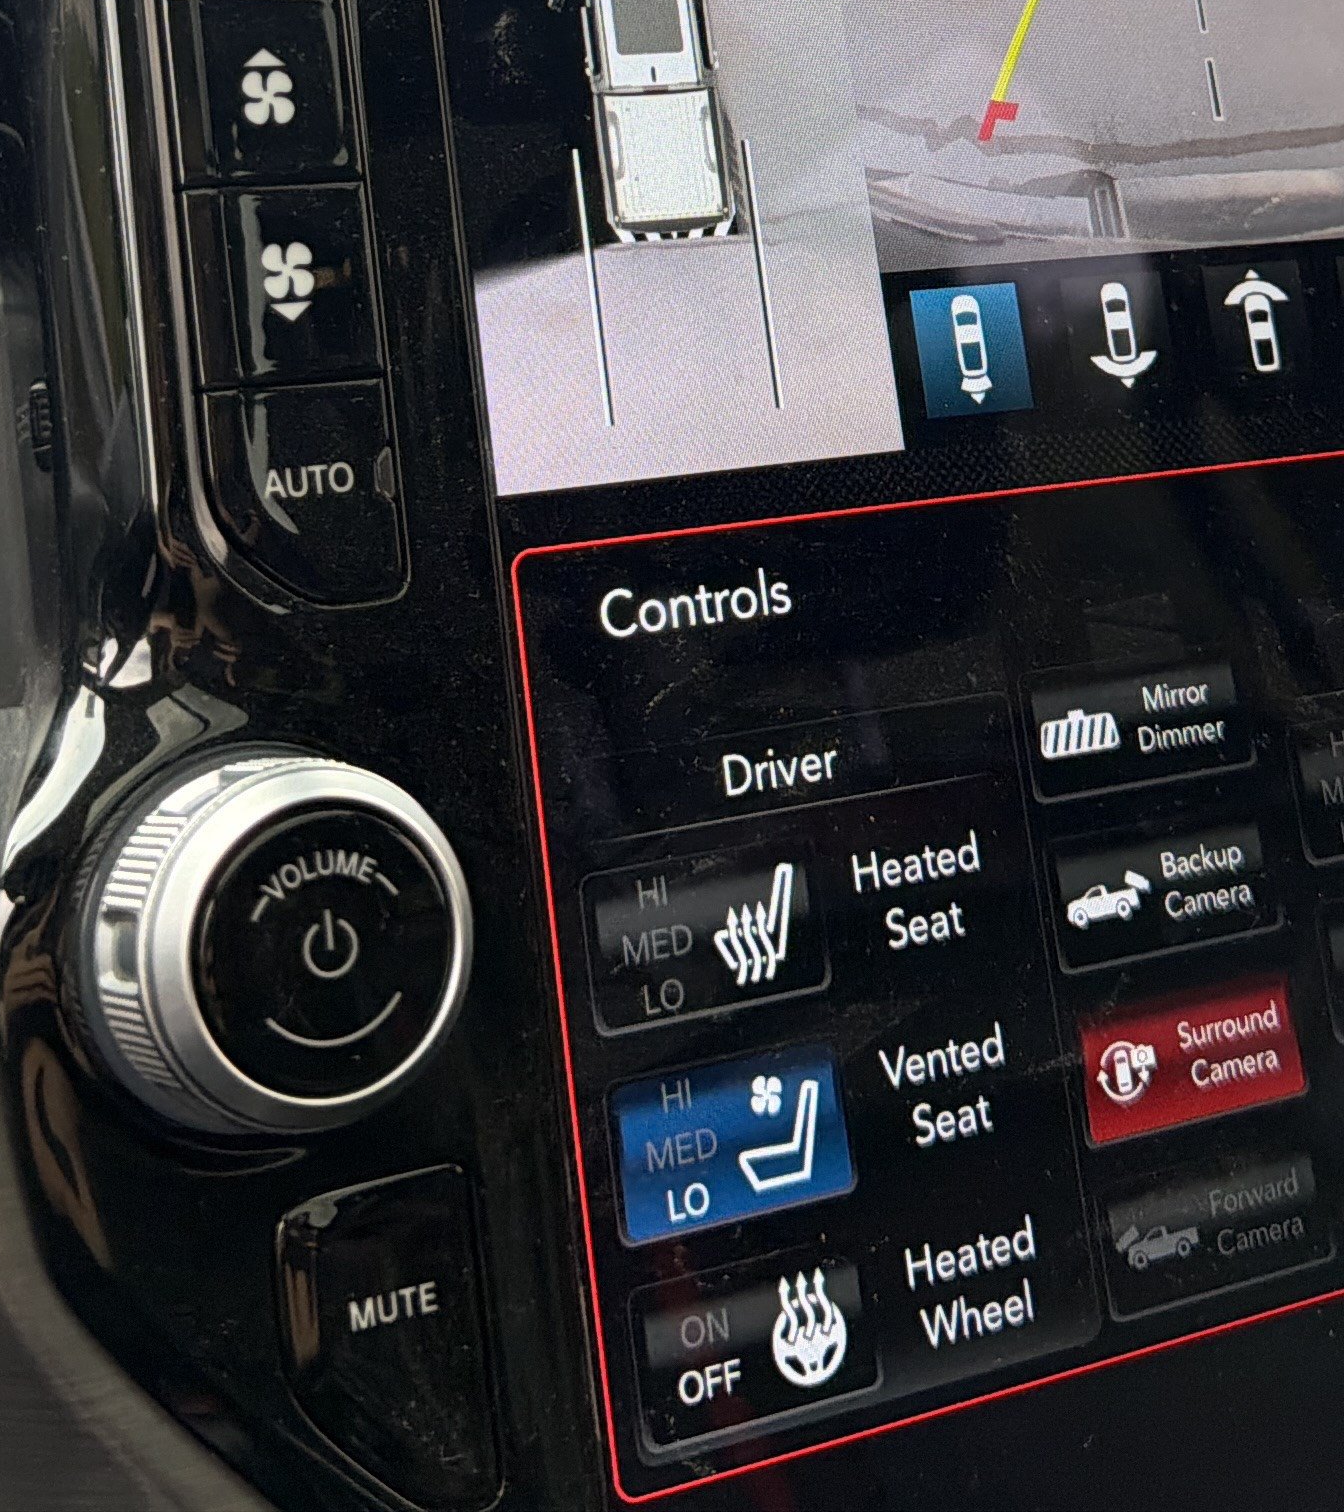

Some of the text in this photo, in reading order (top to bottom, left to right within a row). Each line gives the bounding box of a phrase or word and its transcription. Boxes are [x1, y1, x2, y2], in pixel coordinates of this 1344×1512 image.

[266, 463, 354, 498] AUTO
[599, 568, 793, 639] Controls
[1142, 681, 1208, 710] Mirror
[1137, 717, 1225, 751] Dimmer
[723, 748, 837, 799] Driver
[264, 852, 379, 899] VOLUME
[853, 831, 979, 892] Heated
[1161, 843, 1242, 881] Backup
[637, 878, 669, 908] HI
[1165, 882, 1254, 917] Camera
[622, 925, 693, 963] MED
[886, 902, 965, 950] Seat
[642, 979, 685, 1017] LO
[1177, 1000, 1279, 1048] Surround
[879, 1023, 1005, 1086] Vented
[1191, 1046, 1279, 1087] Camera
[659, 1082, 693, 1112] HI
[912, 1099, 993, 1146] Seat
[645, 1129, 718, 1170] MED
[667, 1182, 709, 1220] LO
[1208, 1168, 1300, 1216] Forward
[904, 1216, 1036, 1289] Heated
[1216, 1214, 1304, 1255] Camera
[349, 1282, 440, 1332] MUTE
[681, 1308, 730, 1346] ON
[919, 1280, 1035, 1349] Wheel
[679, 1359, 742, 1405] OFF
